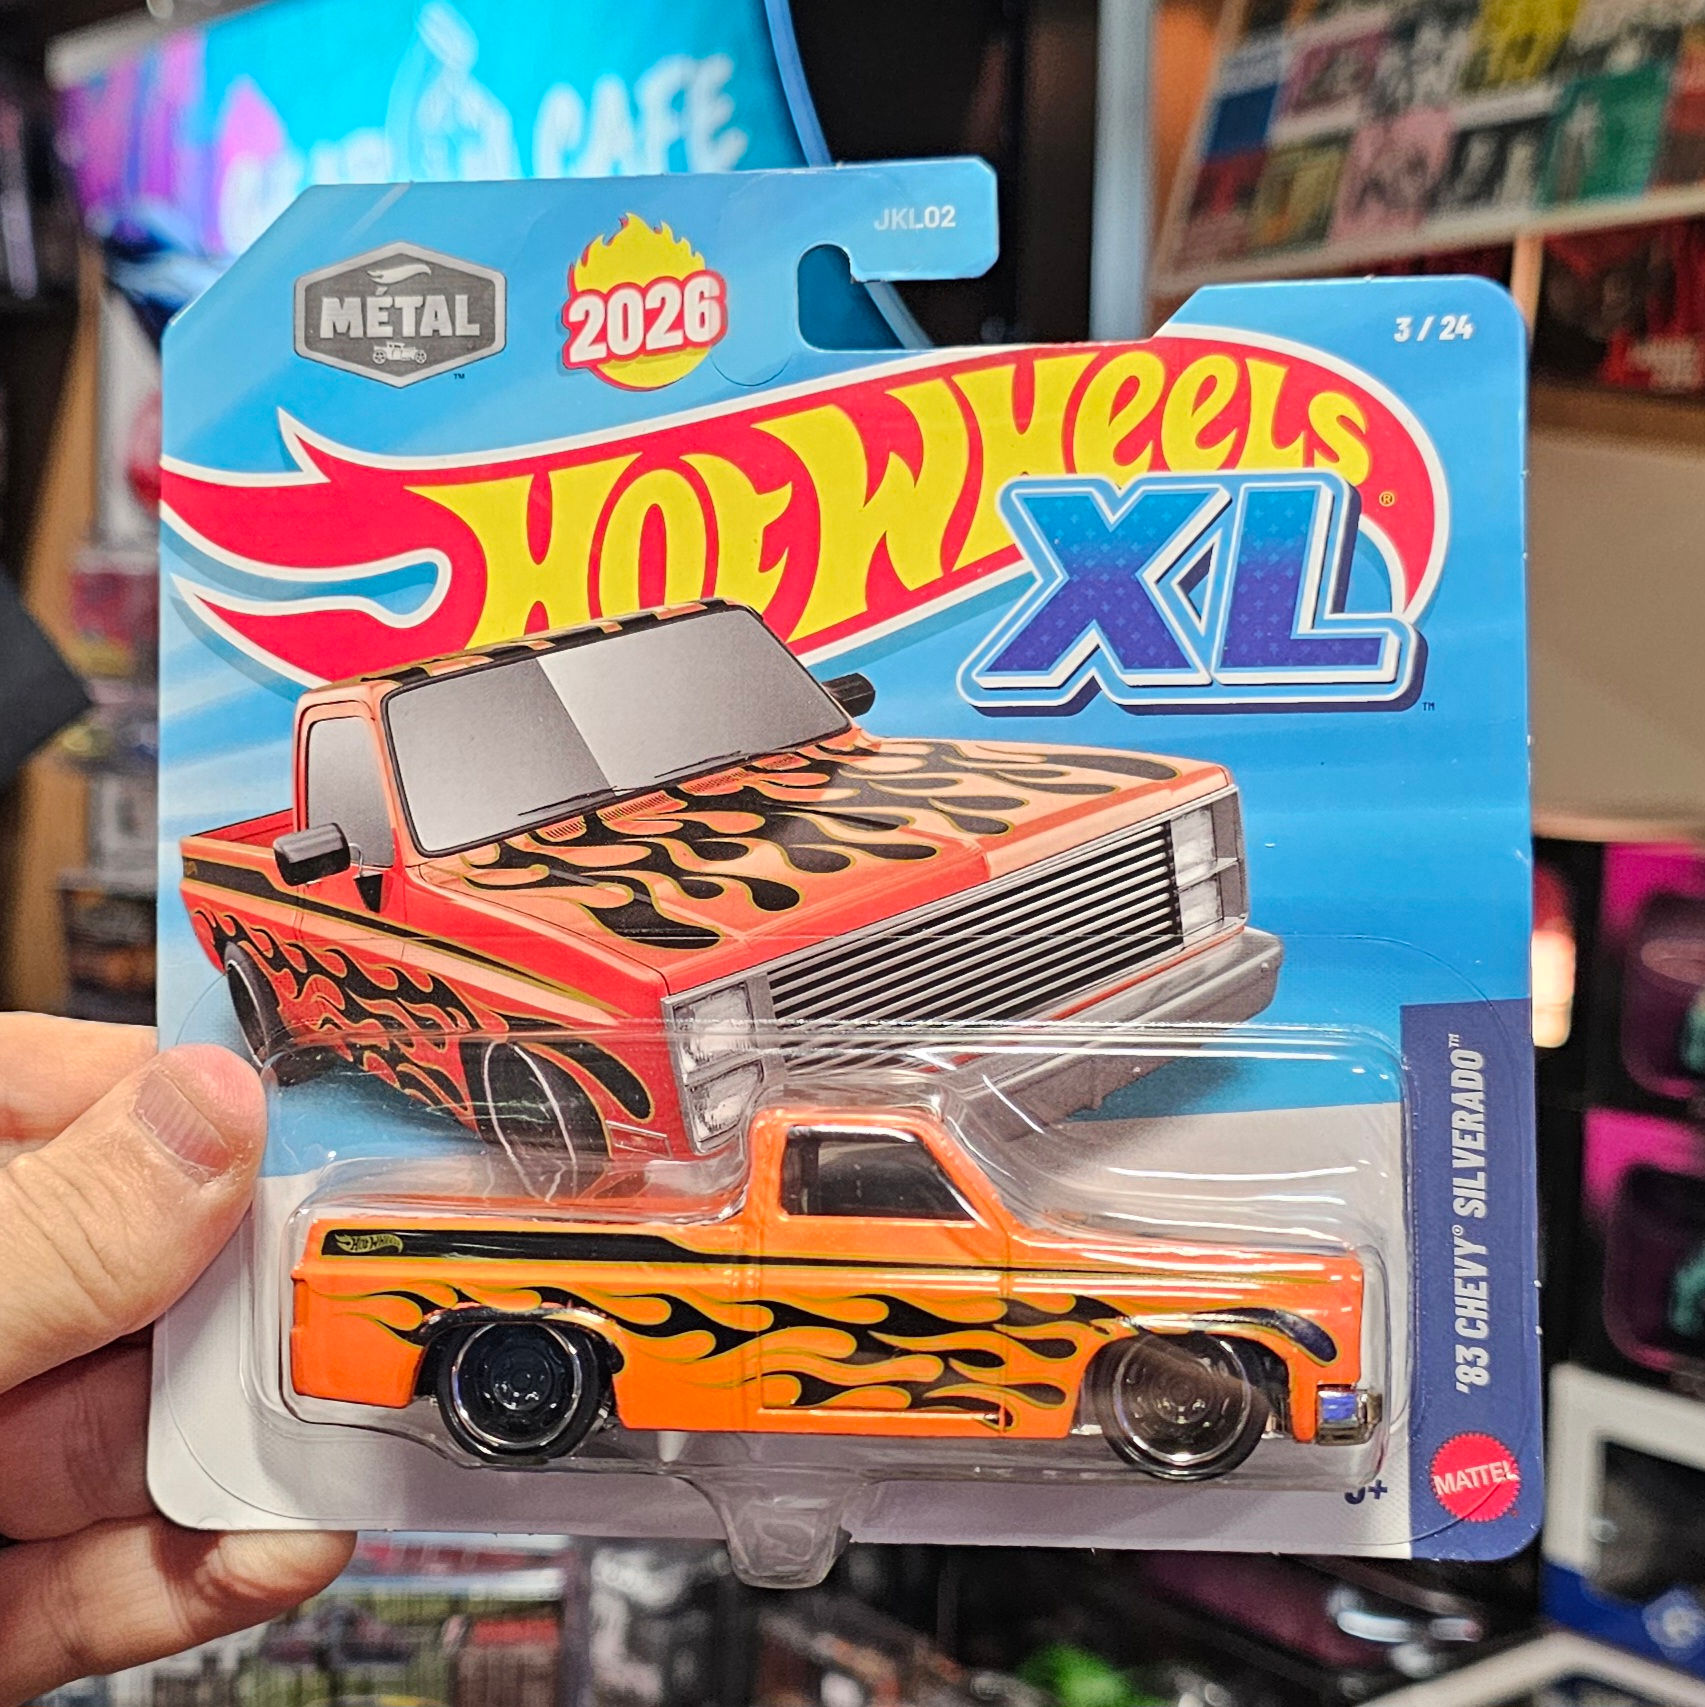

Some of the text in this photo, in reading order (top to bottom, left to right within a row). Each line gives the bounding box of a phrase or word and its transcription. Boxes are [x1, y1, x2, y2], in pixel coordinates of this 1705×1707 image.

[873, 204, 957, 231] JKL02
[319, 285, 481, 339] MÉTAL
[567, 274, 723, 364] 2026
[1393, 313, 1474, 343] 3 / 24
[970, 480, 1402, 690] XL
[1433, 1459, 1520, 1496] MATTEL
